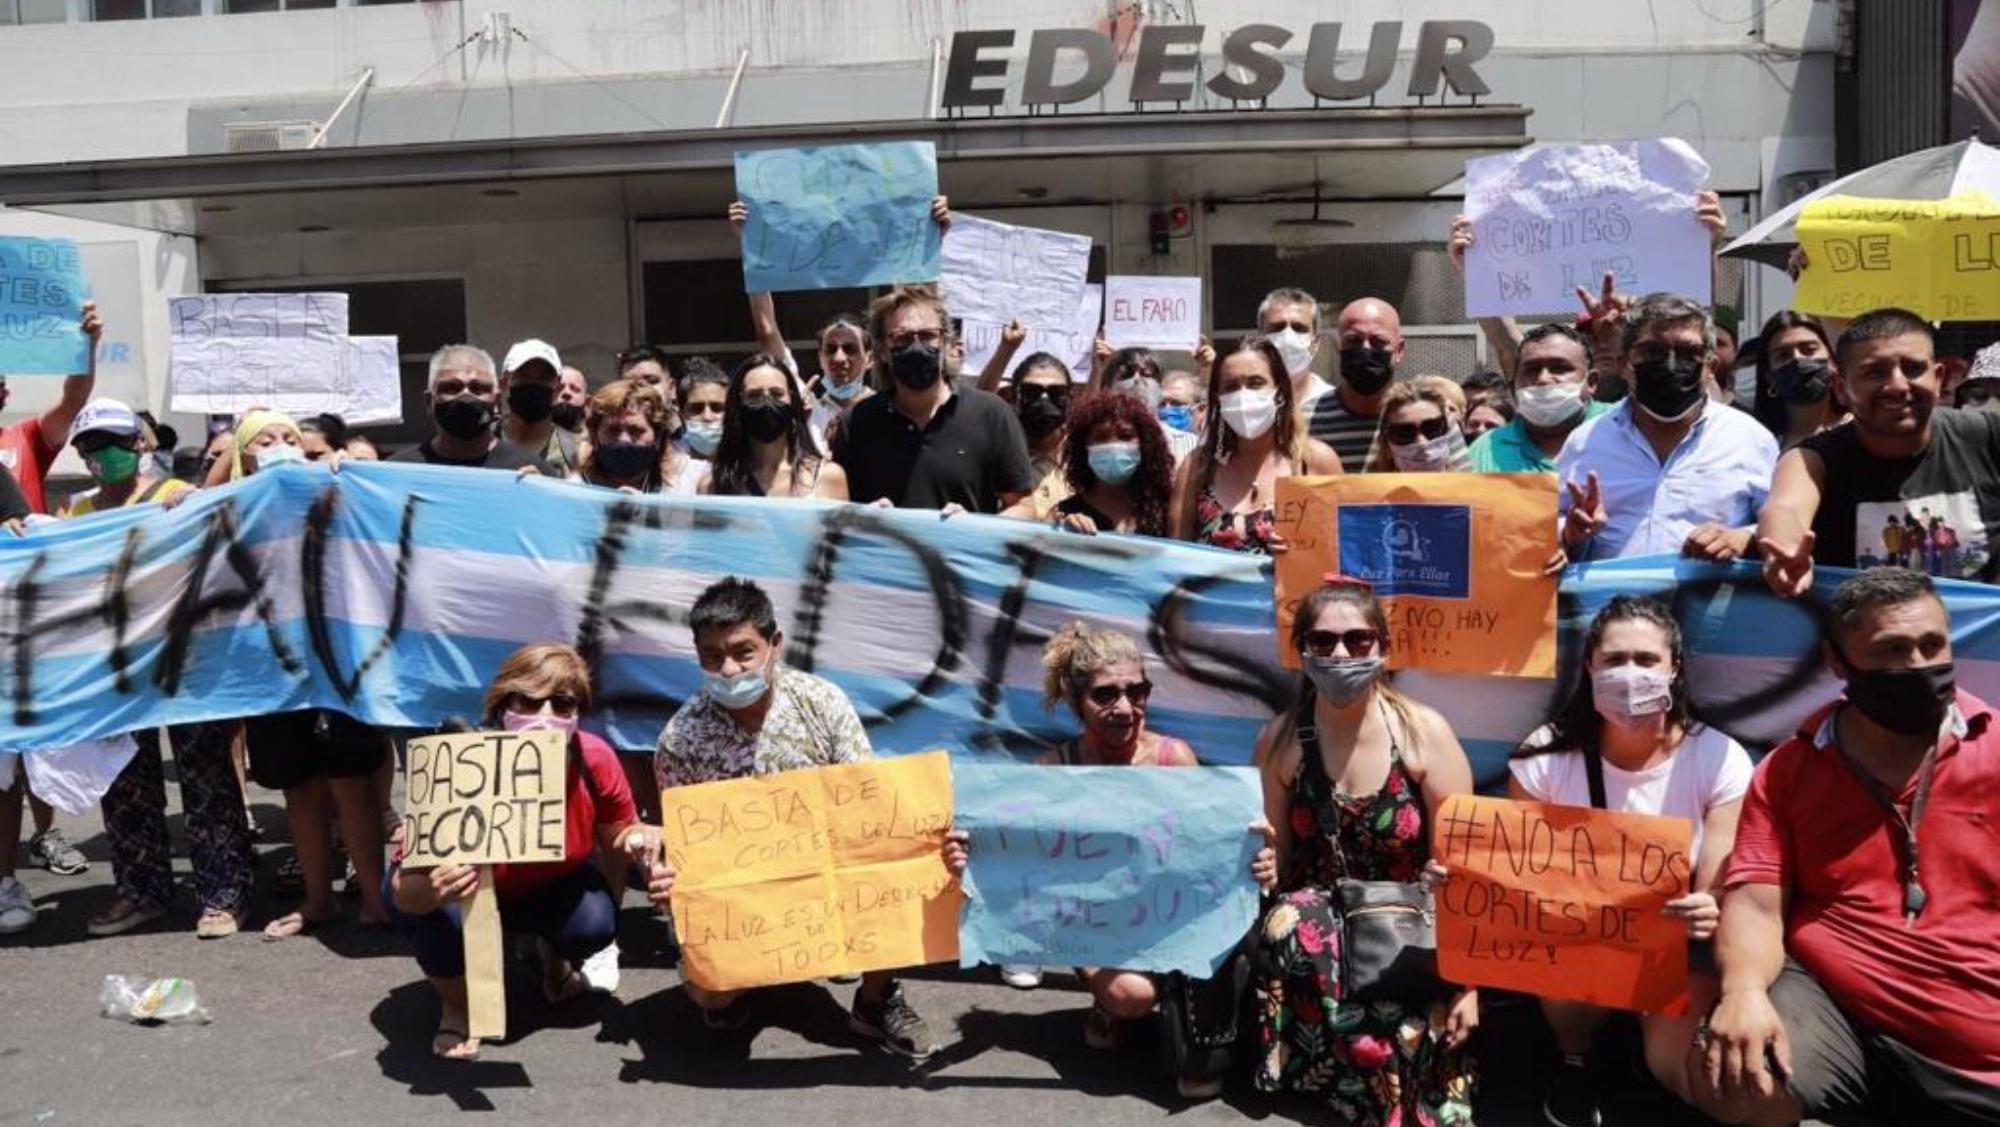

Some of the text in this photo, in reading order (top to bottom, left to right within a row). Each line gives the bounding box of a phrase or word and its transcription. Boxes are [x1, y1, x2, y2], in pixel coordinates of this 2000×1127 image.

[941, 20, 1496, 107] EDESUR
[1824, 234, 1892, 272] DE
[1113, 297, 1186, 322] EL FARO
[1406, 605, 1445, 629] NO
[1457, 607, 1500, 634] HAY
[409, 736, 544, 805] BASTA
[677, 778, 879, 846] BASTA DE
[1572, 826, 1598, 877] A
[1619, 833, 1689, 898] LOS
[1443, 873, 1640, 943] CORTES DE
